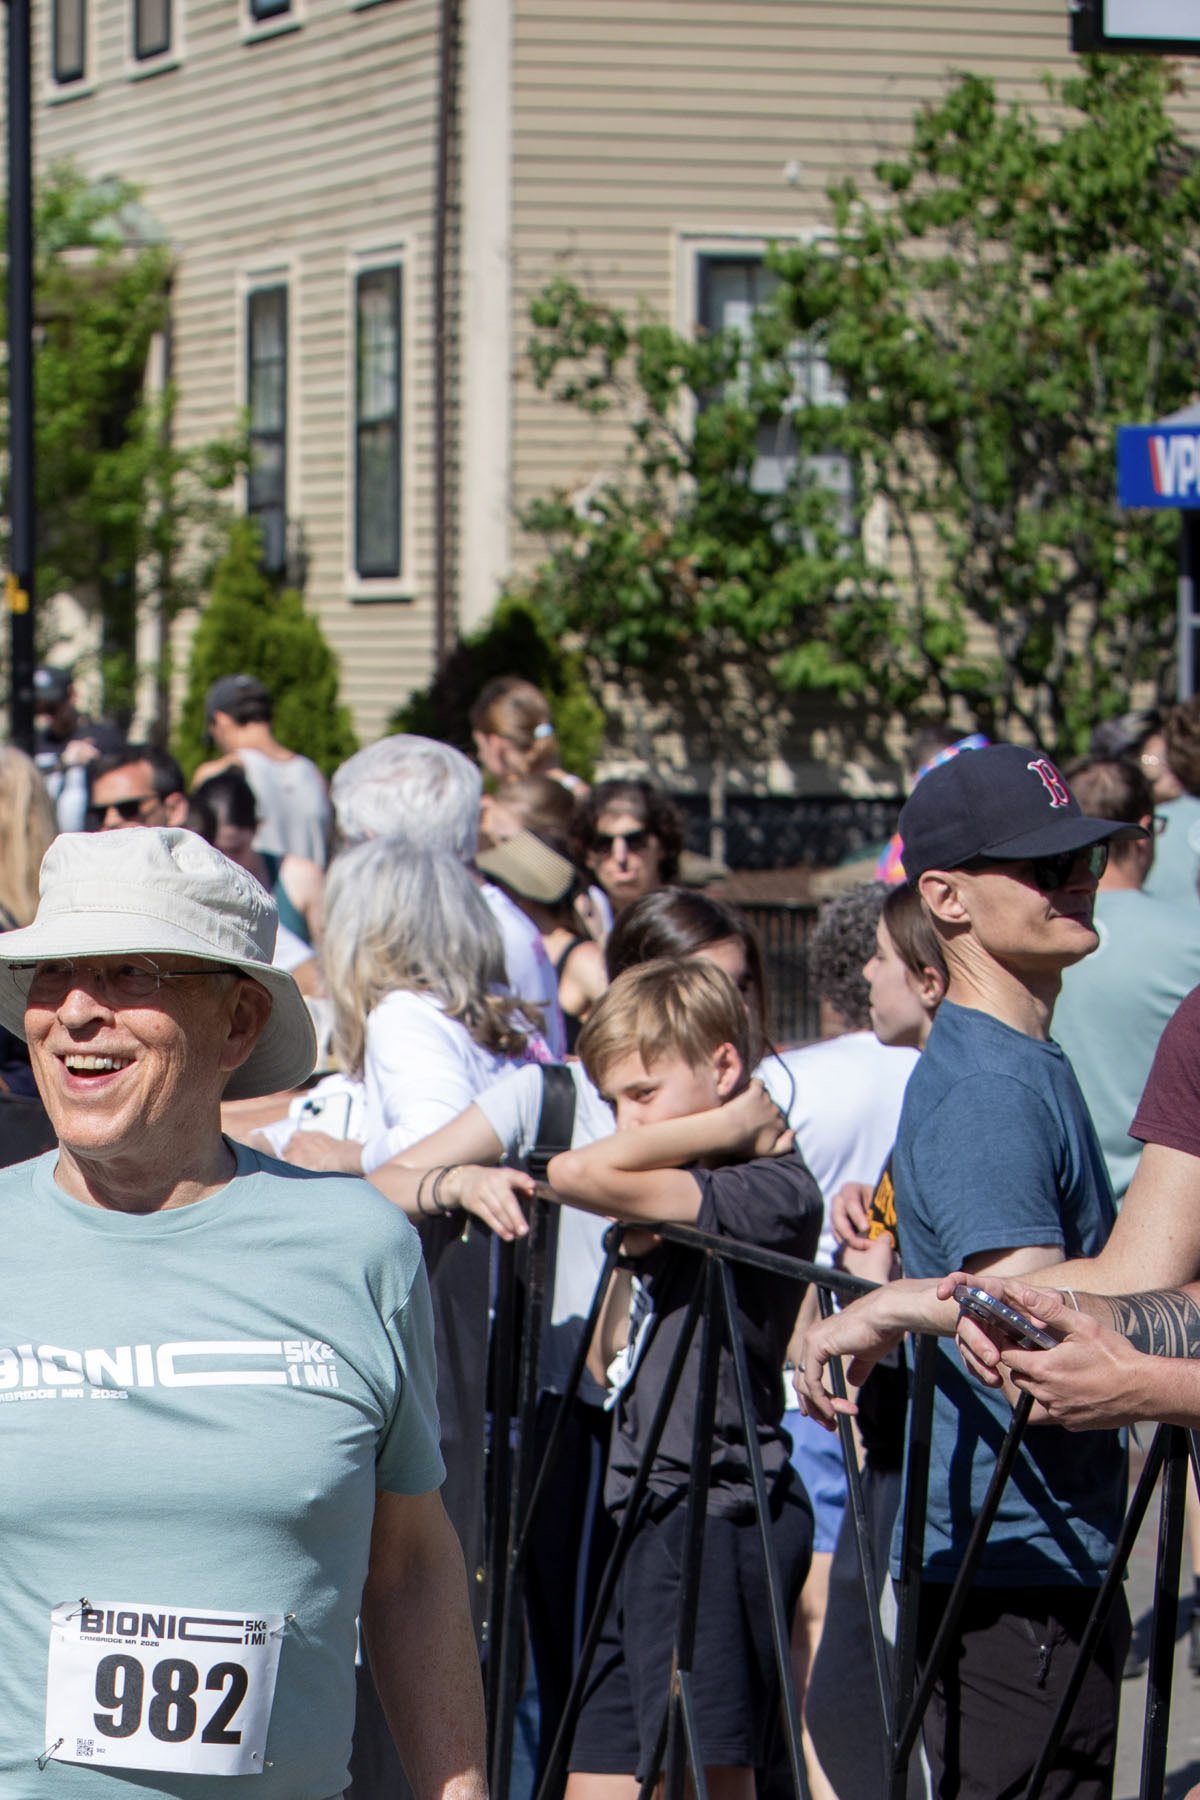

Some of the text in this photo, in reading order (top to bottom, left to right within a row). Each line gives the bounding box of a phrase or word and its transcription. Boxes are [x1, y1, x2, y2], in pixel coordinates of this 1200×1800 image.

[1148, 433, 1200, 497] VP
[1027, 759, 1070, 808] B
[79, 1635, 123, 1644] CAMBRIDGE
[80, 1608, 244, 1645] BIONIC
[93, 1653, 249, 1745] 982
